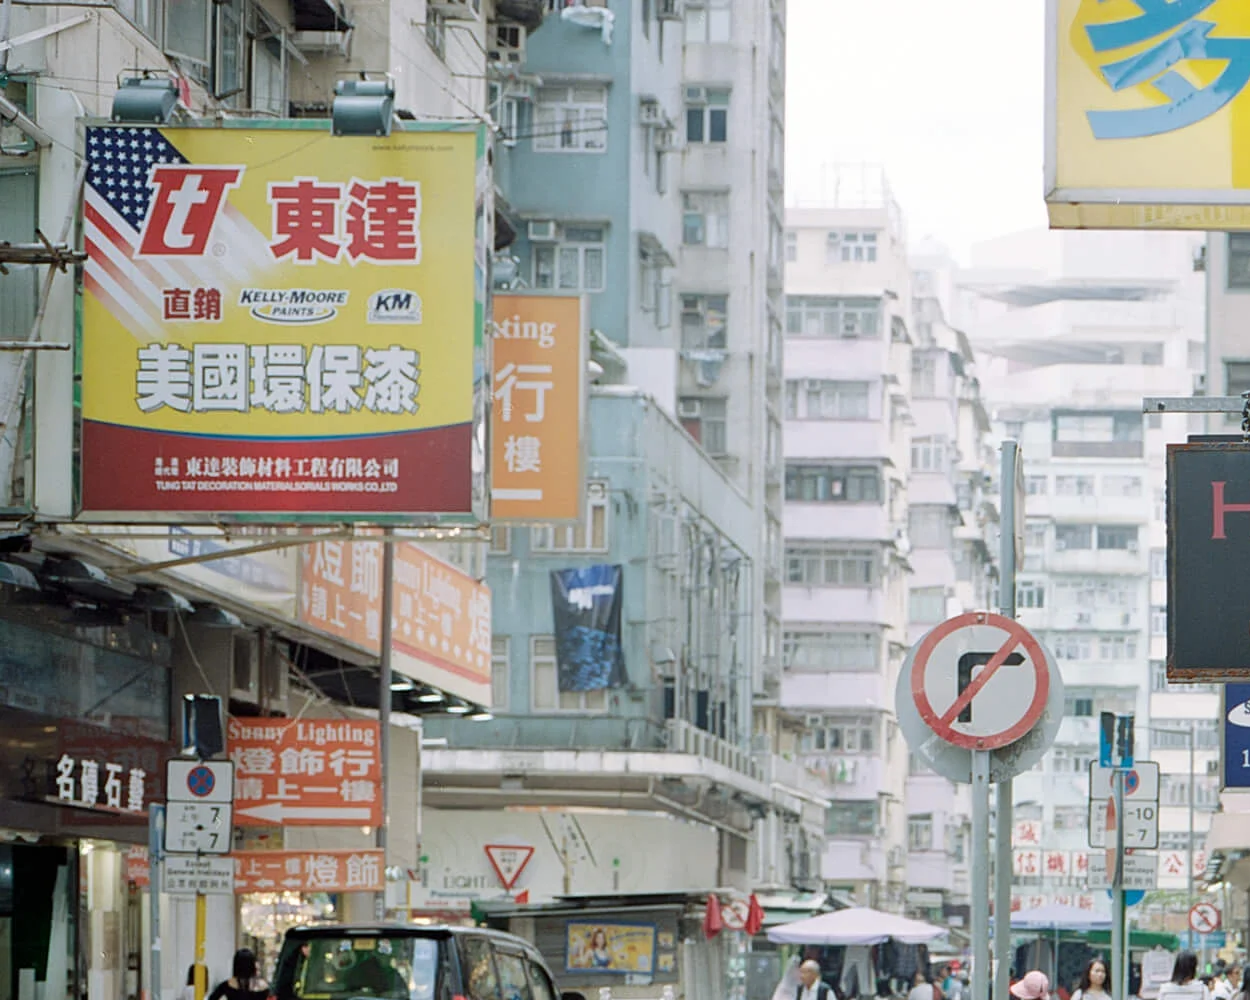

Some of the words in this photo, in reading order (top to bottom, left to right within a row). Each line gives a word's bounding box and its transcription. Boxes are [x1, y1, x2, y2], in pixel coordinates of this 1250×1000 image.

[269, 179, 419, 264] 東達
[162, 287, 222, 320] 直銷
[240, 290, 347, 304] KELLY-MOORE
[375, 293, 412, 311] KM
[271, 306, 314, 317] PAINTS
[493, 315, 556, 348] ting
[136, 343, 420, 414] 美國環保漆
[495, 363, 553, 422] 行
[186, 456, 399, 478] 東達裝飾材料工程有限公司
[228, 722, 286, 745] Sunny
[296, 722, 375, 746] Lighting
[229, 747, 376, 777] 燈飾行
[210, 807, 220, 824] 7
[209, 833, 219, 849] 7
[305, 854, 379, 888] 燈飾
